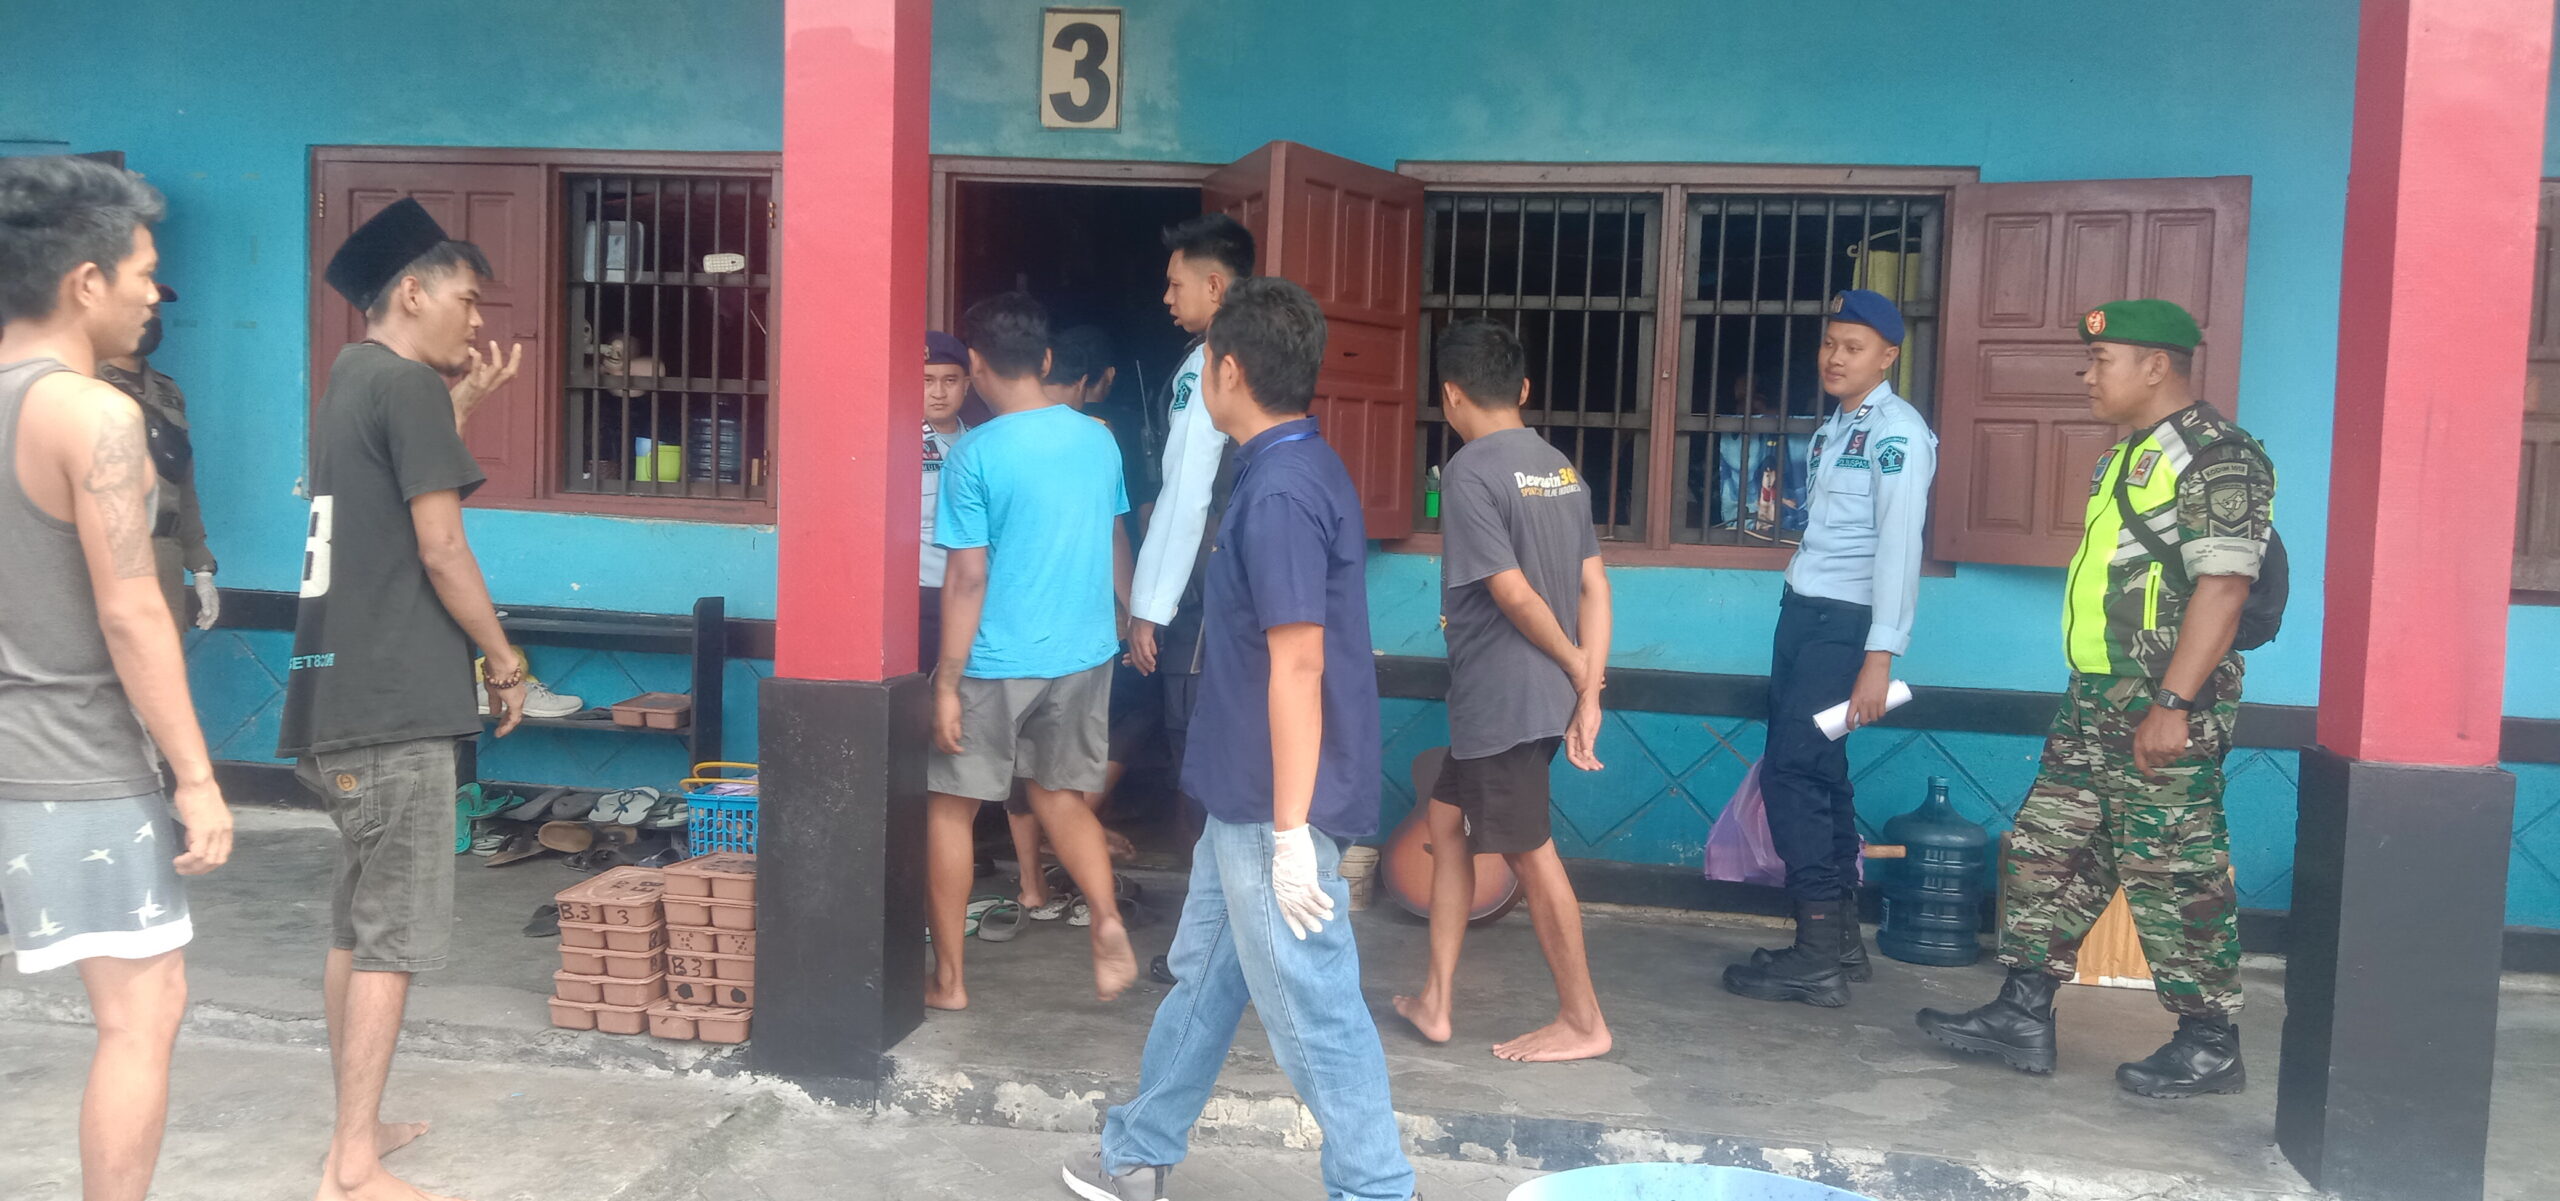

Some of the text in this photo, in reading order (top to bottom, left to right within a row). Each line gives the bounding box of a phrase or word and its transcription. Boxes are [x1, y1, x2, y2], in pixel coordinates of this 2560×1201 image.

[1049, 22, 1111, 123] 3
[560, 903, 591, 921] B.3
[616, 909, 630, 925] 3
